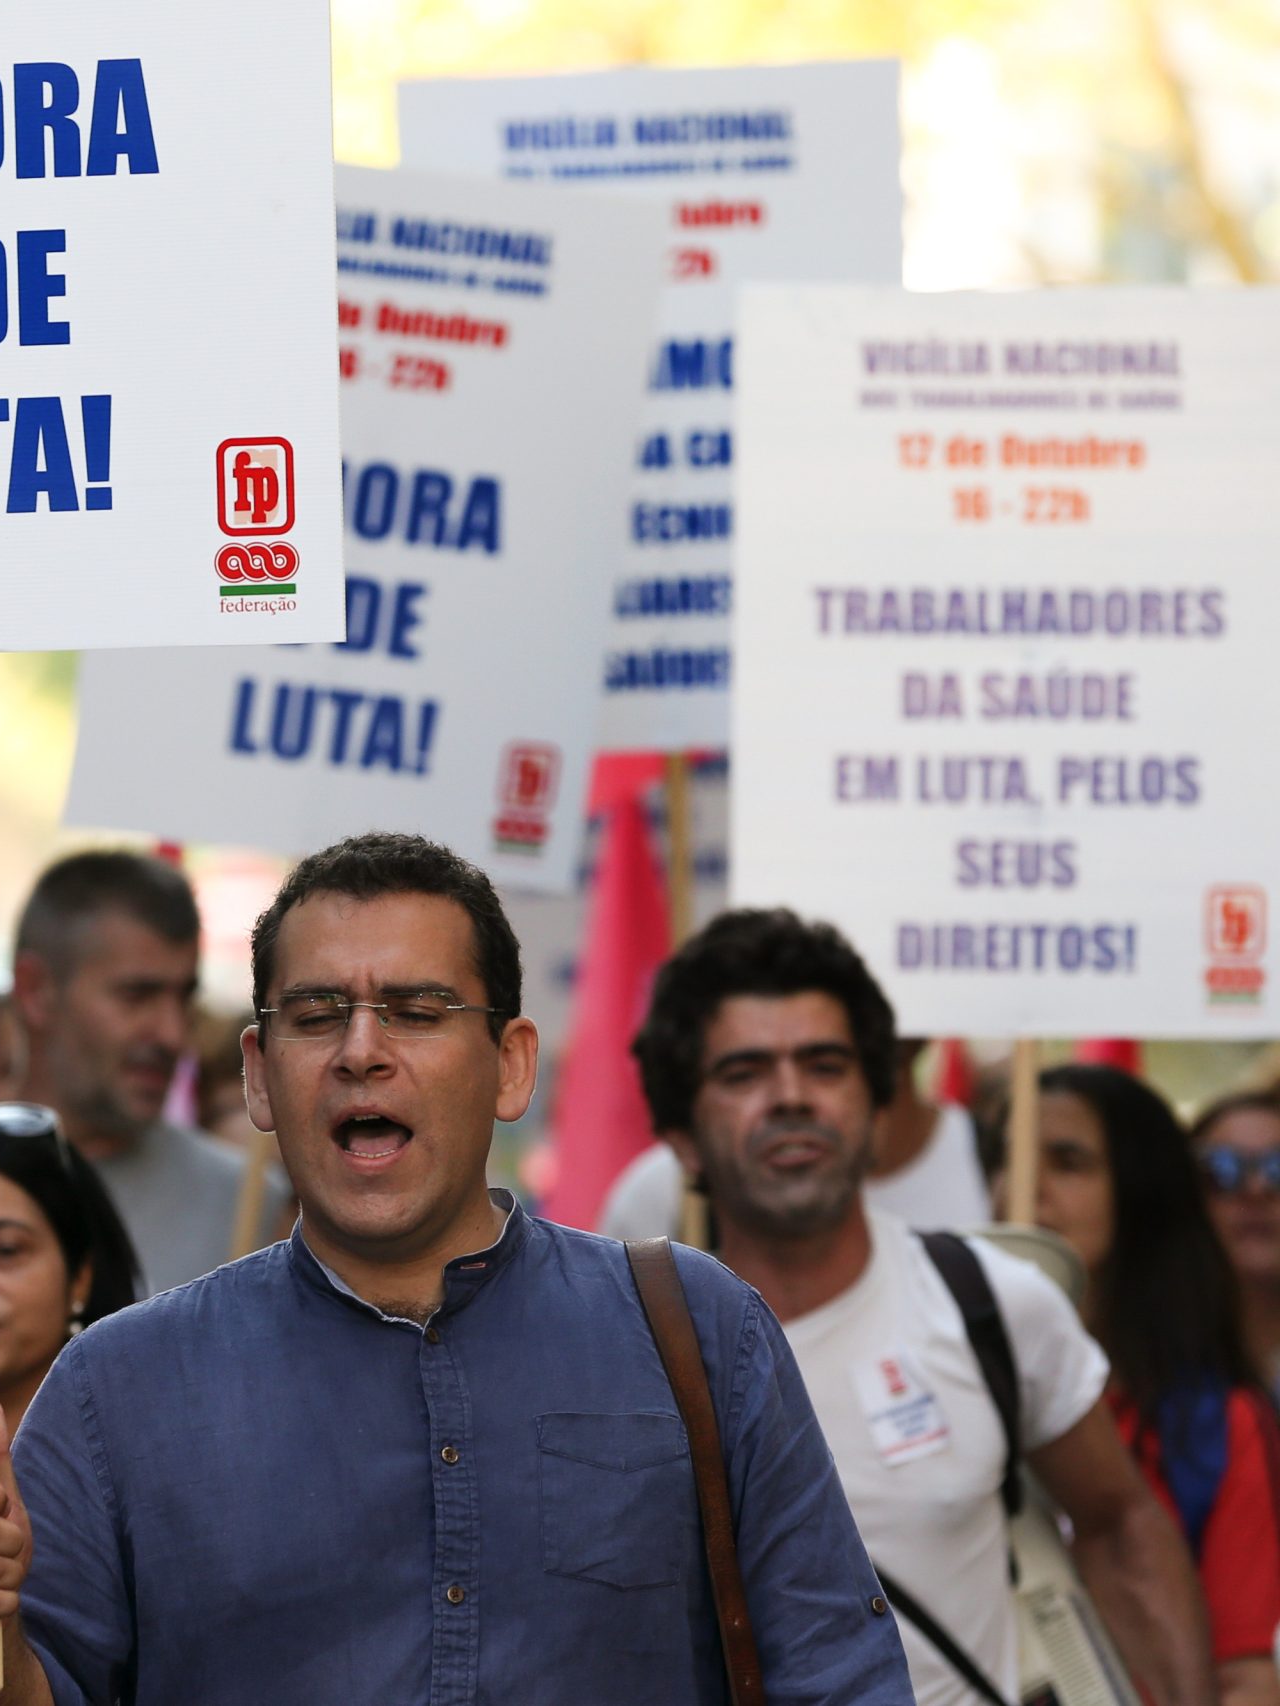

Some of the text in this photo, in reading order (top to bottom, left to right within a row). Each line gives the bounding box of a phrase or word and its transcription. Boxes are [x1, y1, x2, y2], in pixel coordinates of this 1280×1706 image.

[860, 333, 1180, 377] VIGÍLIA NACIONAL
[899, 431, 1146, 469] 12 de Outubro
[342, 459, 504, 555] ORA
[954, 487, 989, 522] 16
[1023, 487, 1090, 522] 22h
[219, 597, 297, 615] federação
[815, 588, 1227, 638] TRABALHADORES
[902, 660, 1136, 722] DA SAÚDE
[230, 675, 441, 776] LUTA!
[835, 755, 1200, 810] EM LUTA, PELOS
[956, 841, 1077, 888] SEUS
[897, 924, 1137, 971] DIREITOS!
